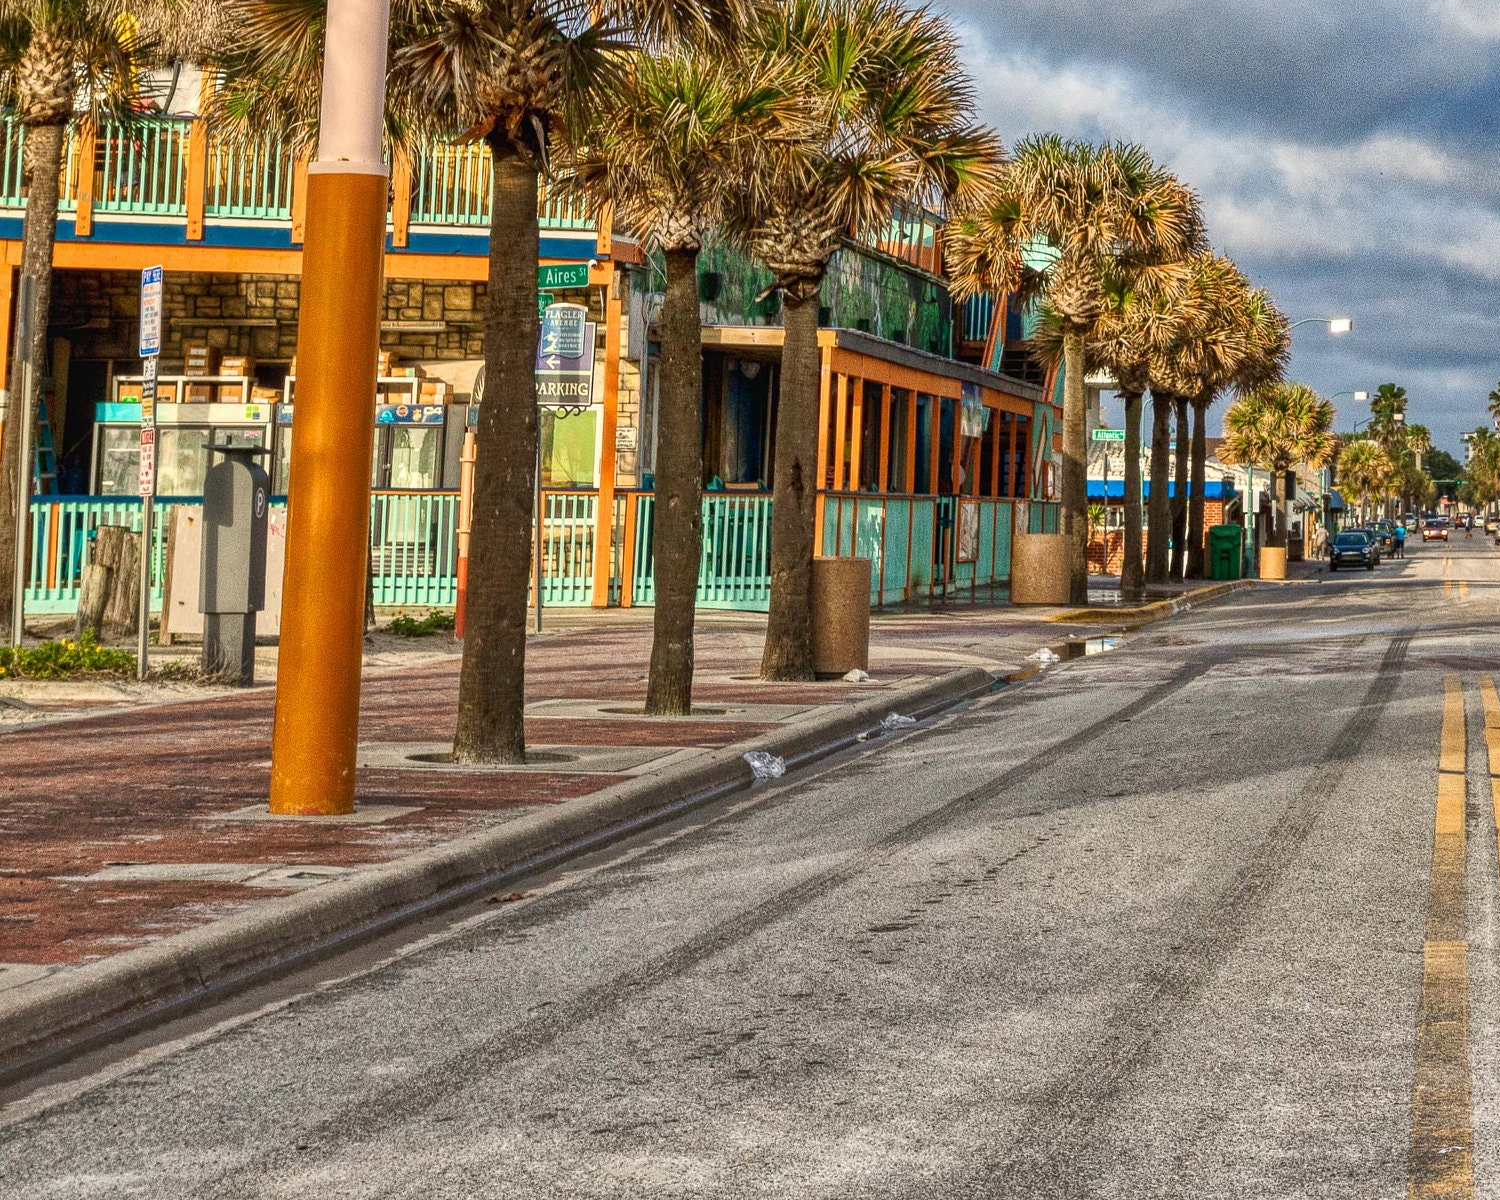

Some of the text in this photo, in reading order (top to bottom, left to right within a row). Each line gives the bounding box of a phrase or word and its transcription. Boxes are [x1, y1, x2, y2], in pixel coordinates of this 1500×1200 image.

[545, 266, 587, 285] Aires St
[545, 310, 583, 319] FLAGLER
[257, 493, 263, 513] P
